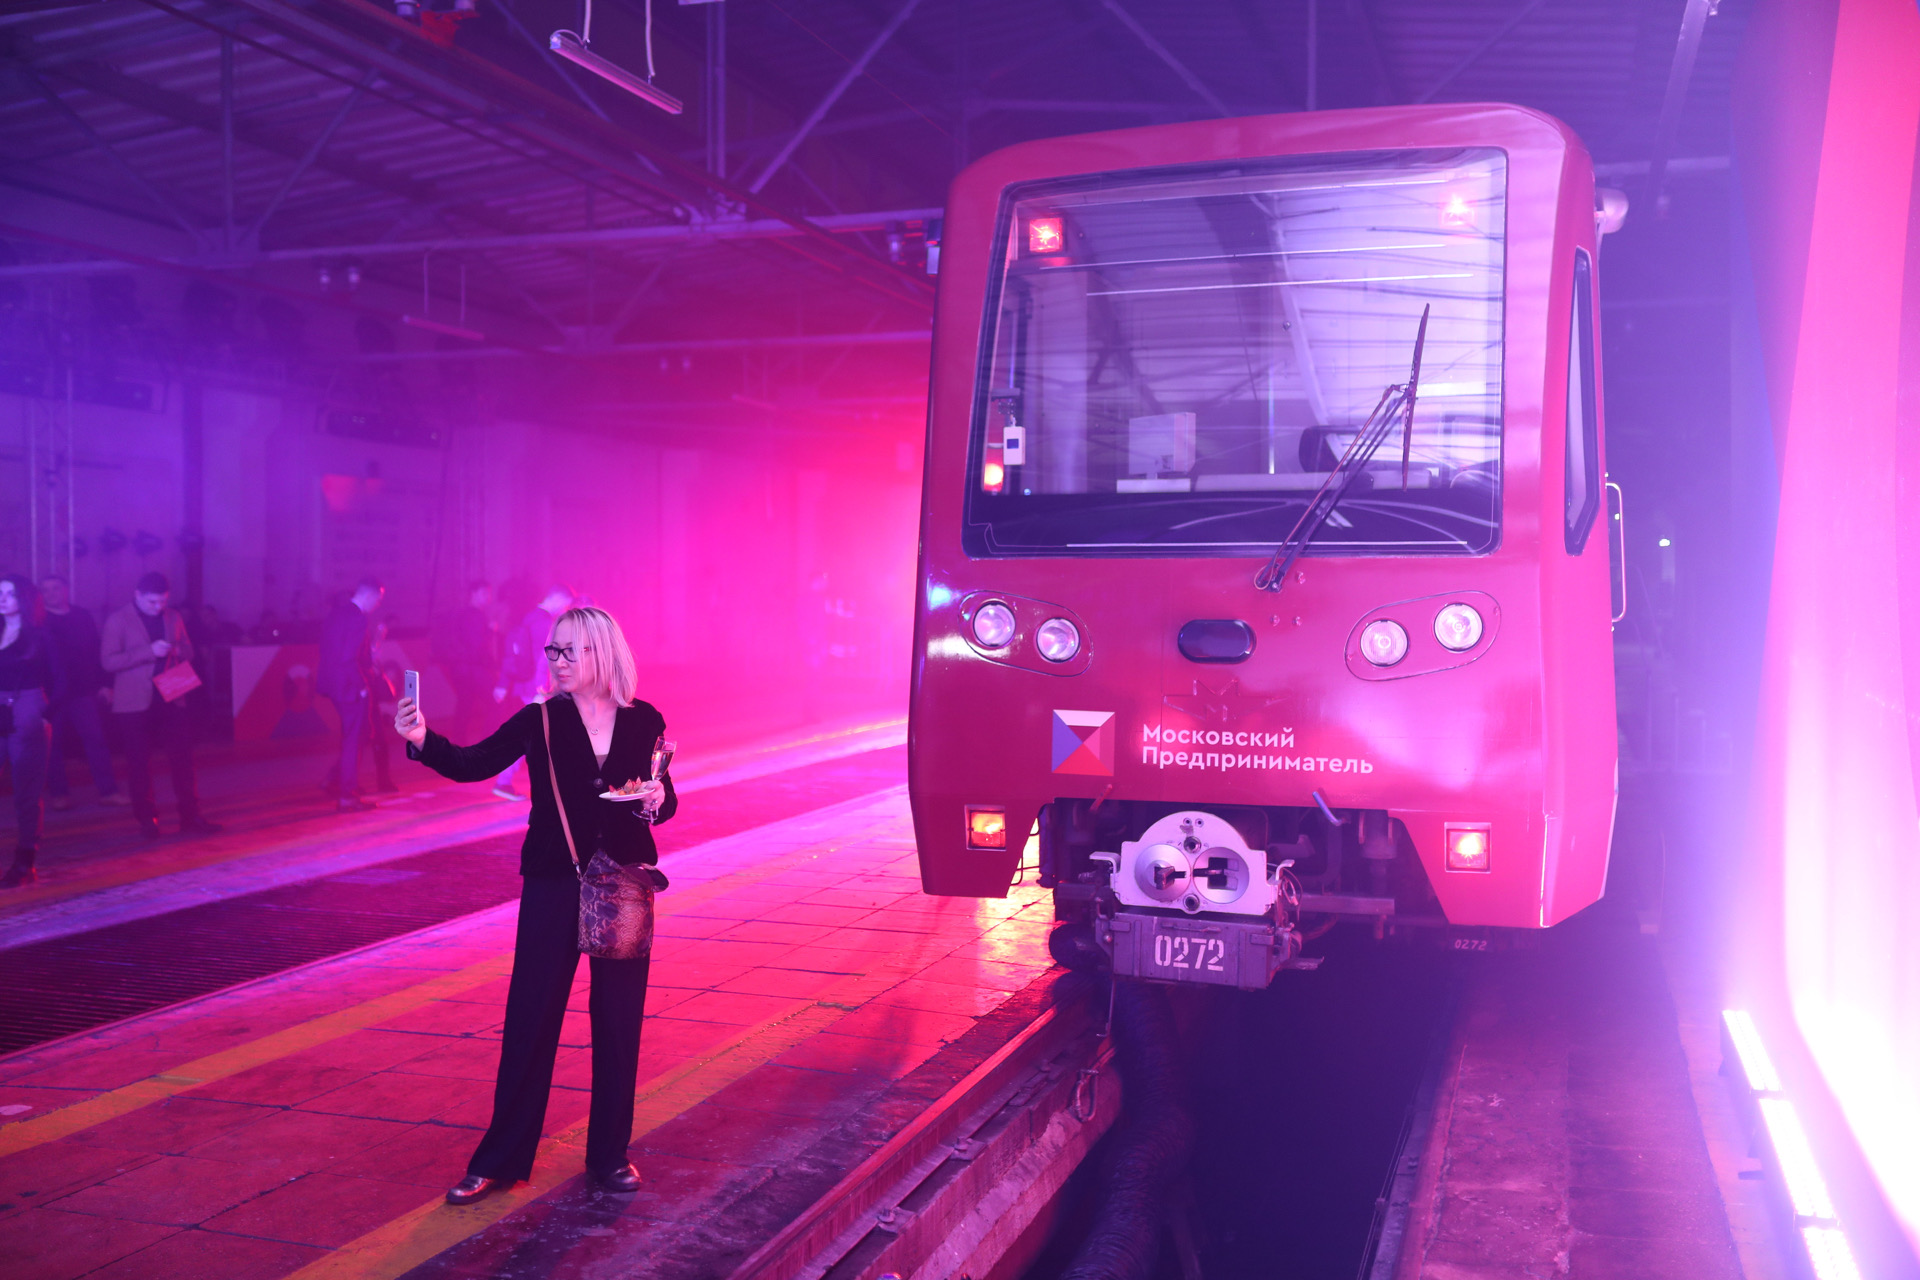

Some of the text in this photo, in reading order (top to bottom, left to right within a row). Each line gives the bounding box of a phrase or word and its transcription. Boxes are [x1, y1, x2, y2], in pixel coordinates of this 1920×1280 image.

[1142, 724, 1295, 748] Московский
[1142, 746, 1374, 774] Предприниматель
[1154, 935, 1224, 971] 0272
[1454, 939, 1487, 951] 0272
